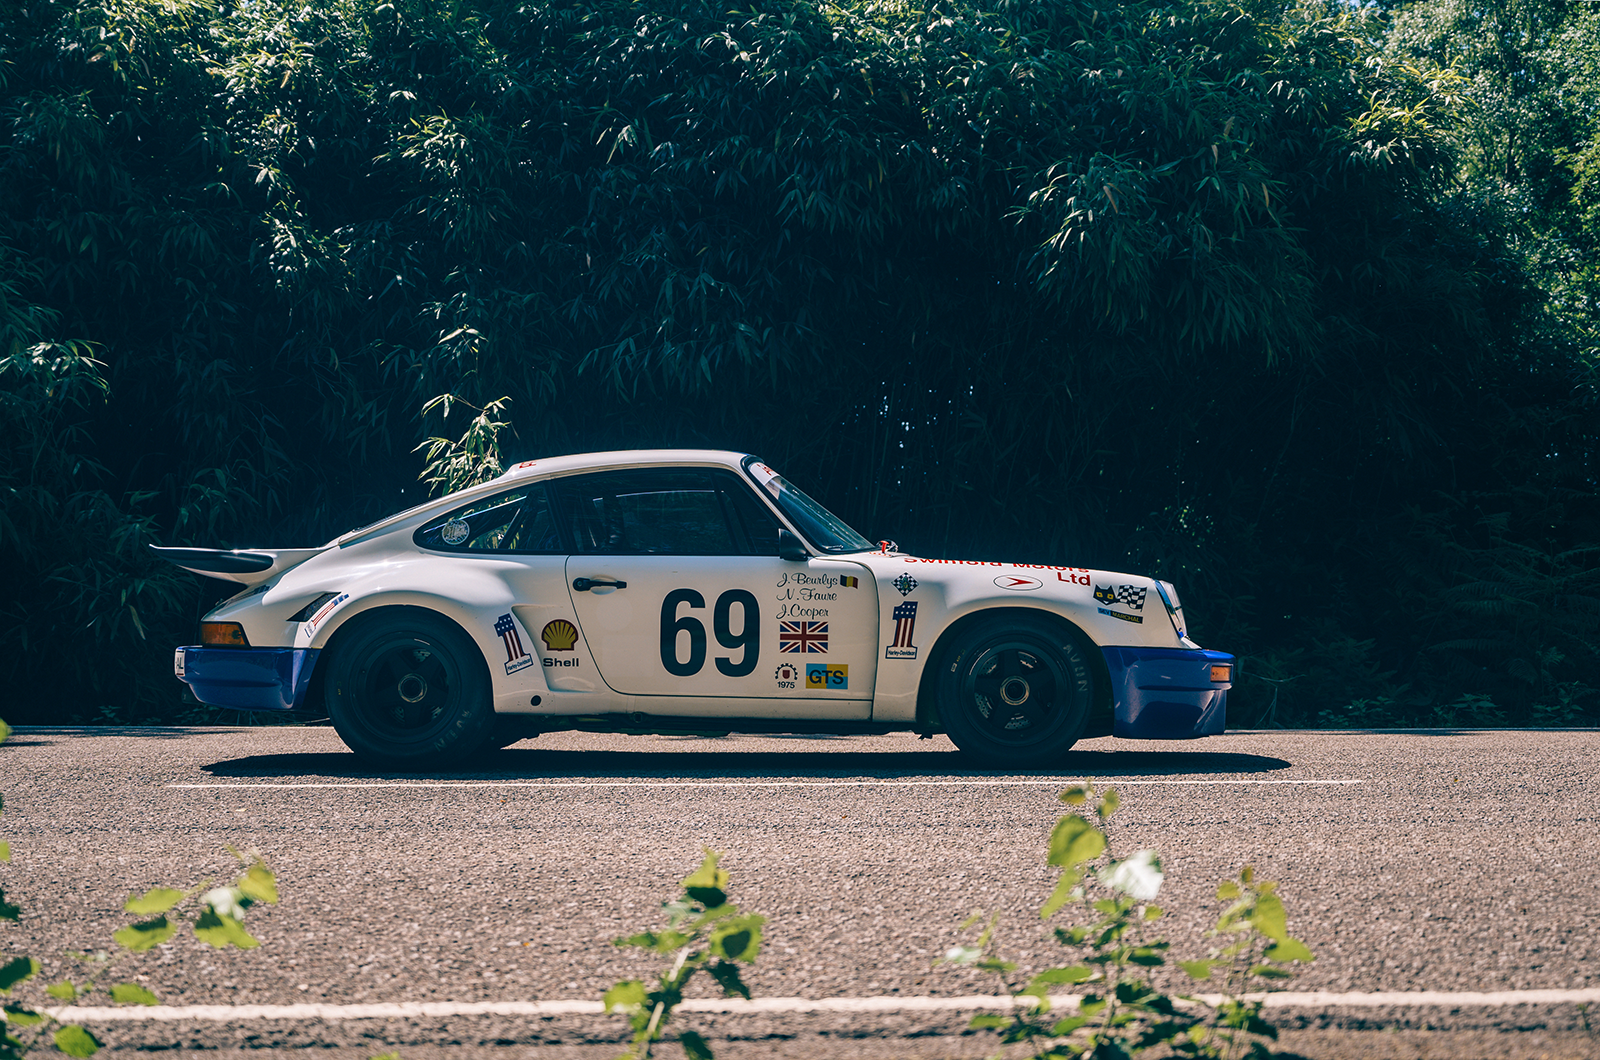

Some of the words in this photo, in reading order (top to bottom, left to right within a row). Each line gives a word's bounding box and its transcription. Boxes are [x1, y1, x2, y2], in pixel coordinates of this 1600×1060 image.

[1057, 571, 1091, 586] Ltd
[800, 587, 838, 601] Faure
[660, 588, 761, 677] 69
[543, 657, 580, 668] Shell
[809, 669, 844, 685] GTS
[777, 681, 796, 689] 1975
